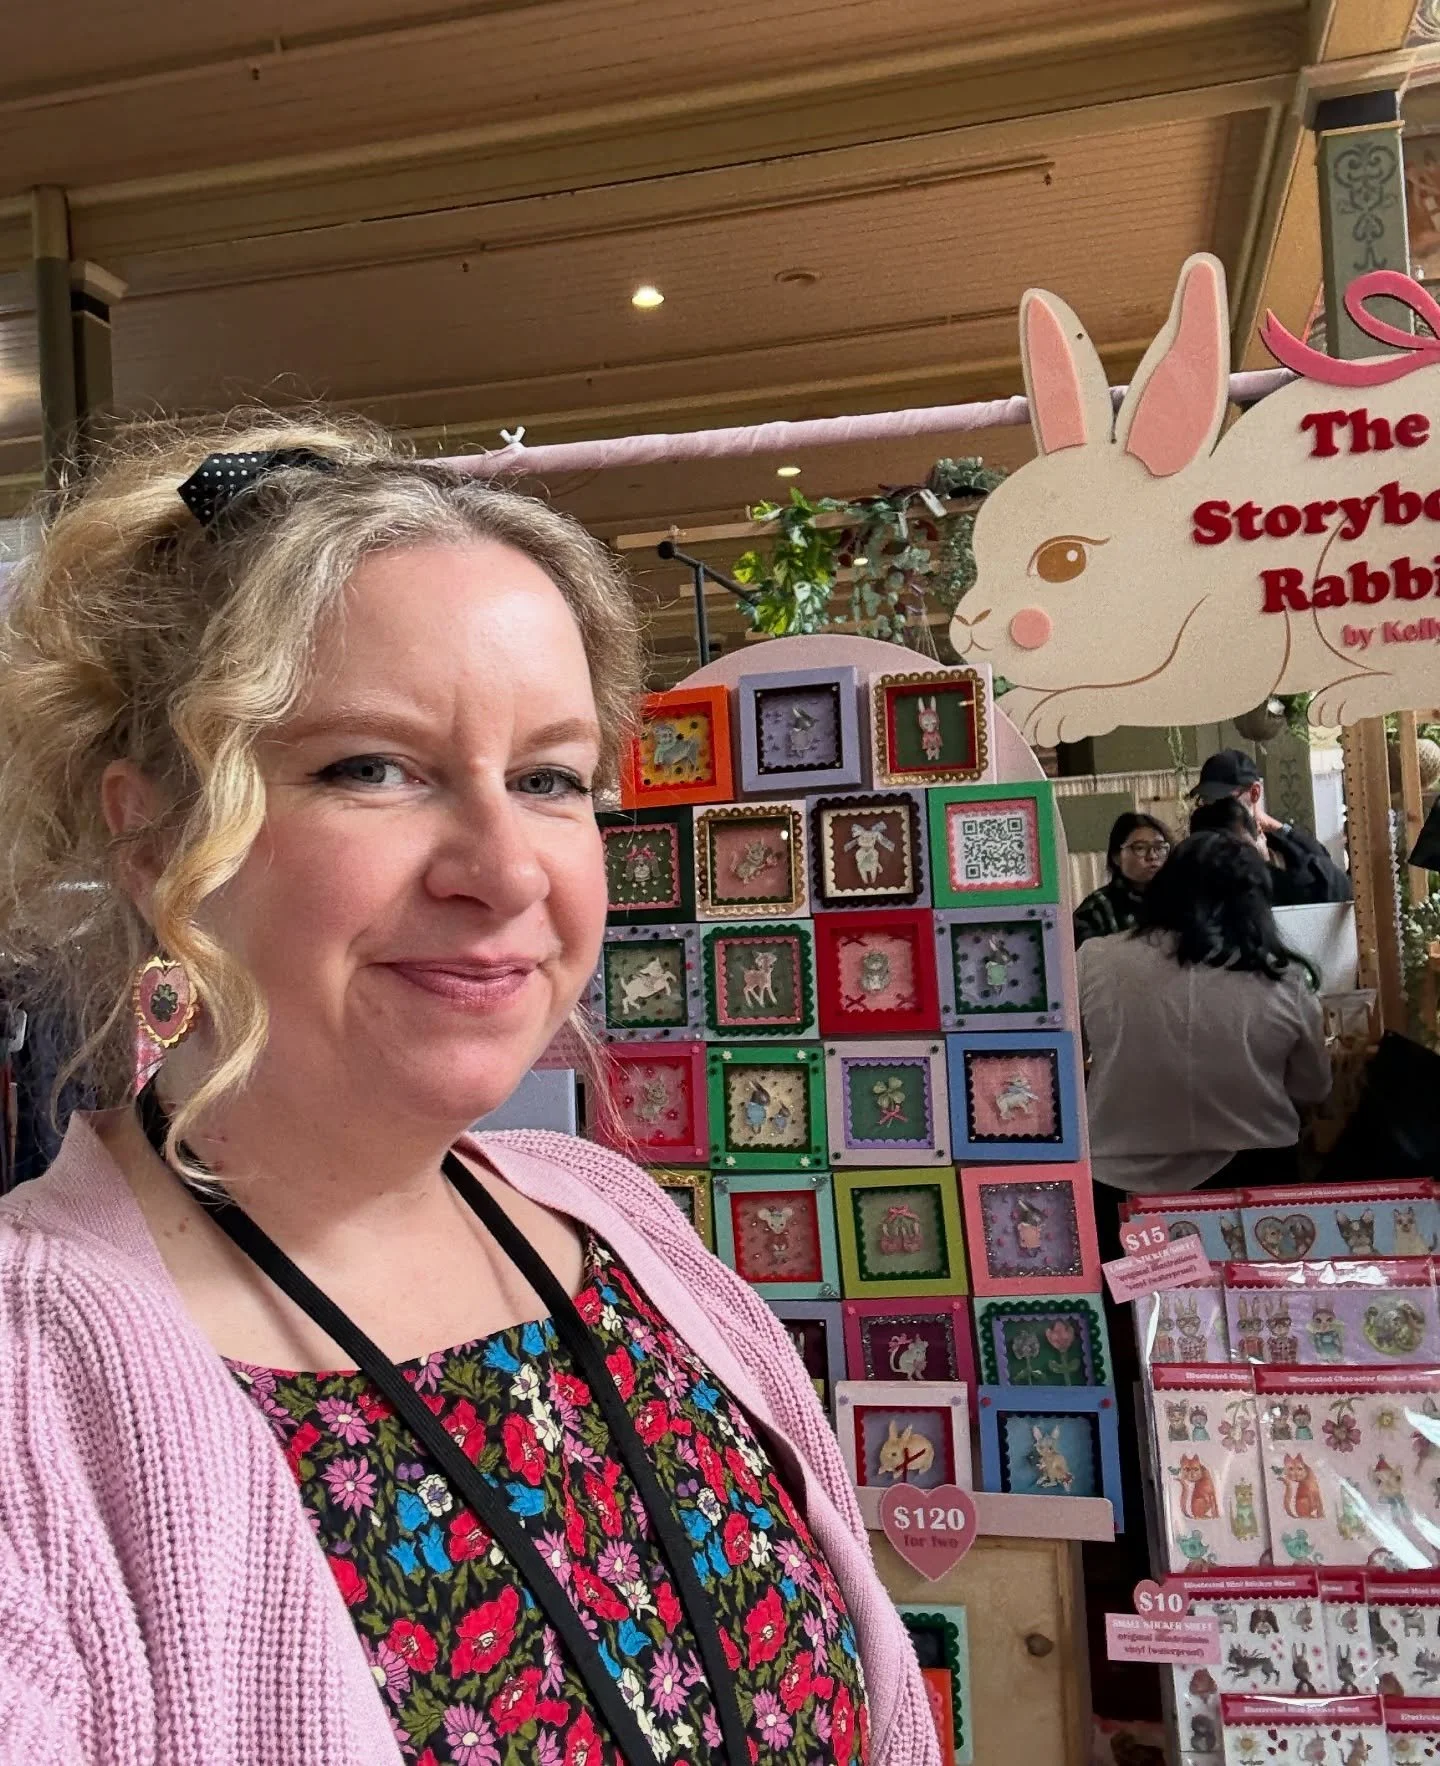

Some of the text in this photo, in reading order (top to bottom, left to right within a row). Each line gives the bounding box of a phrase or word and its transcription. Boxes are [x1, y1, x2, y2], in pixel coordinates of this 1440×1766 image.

[1301, 408, 1431, 459] The
[1343, 624, 1376, 650] by
[1126, 1226, 1165, 1251] $15
[894, 1506, 965, 1531] $120
[904, 1534, 925, 1547] for
[1139, 1591, 1183, 1613] $10
